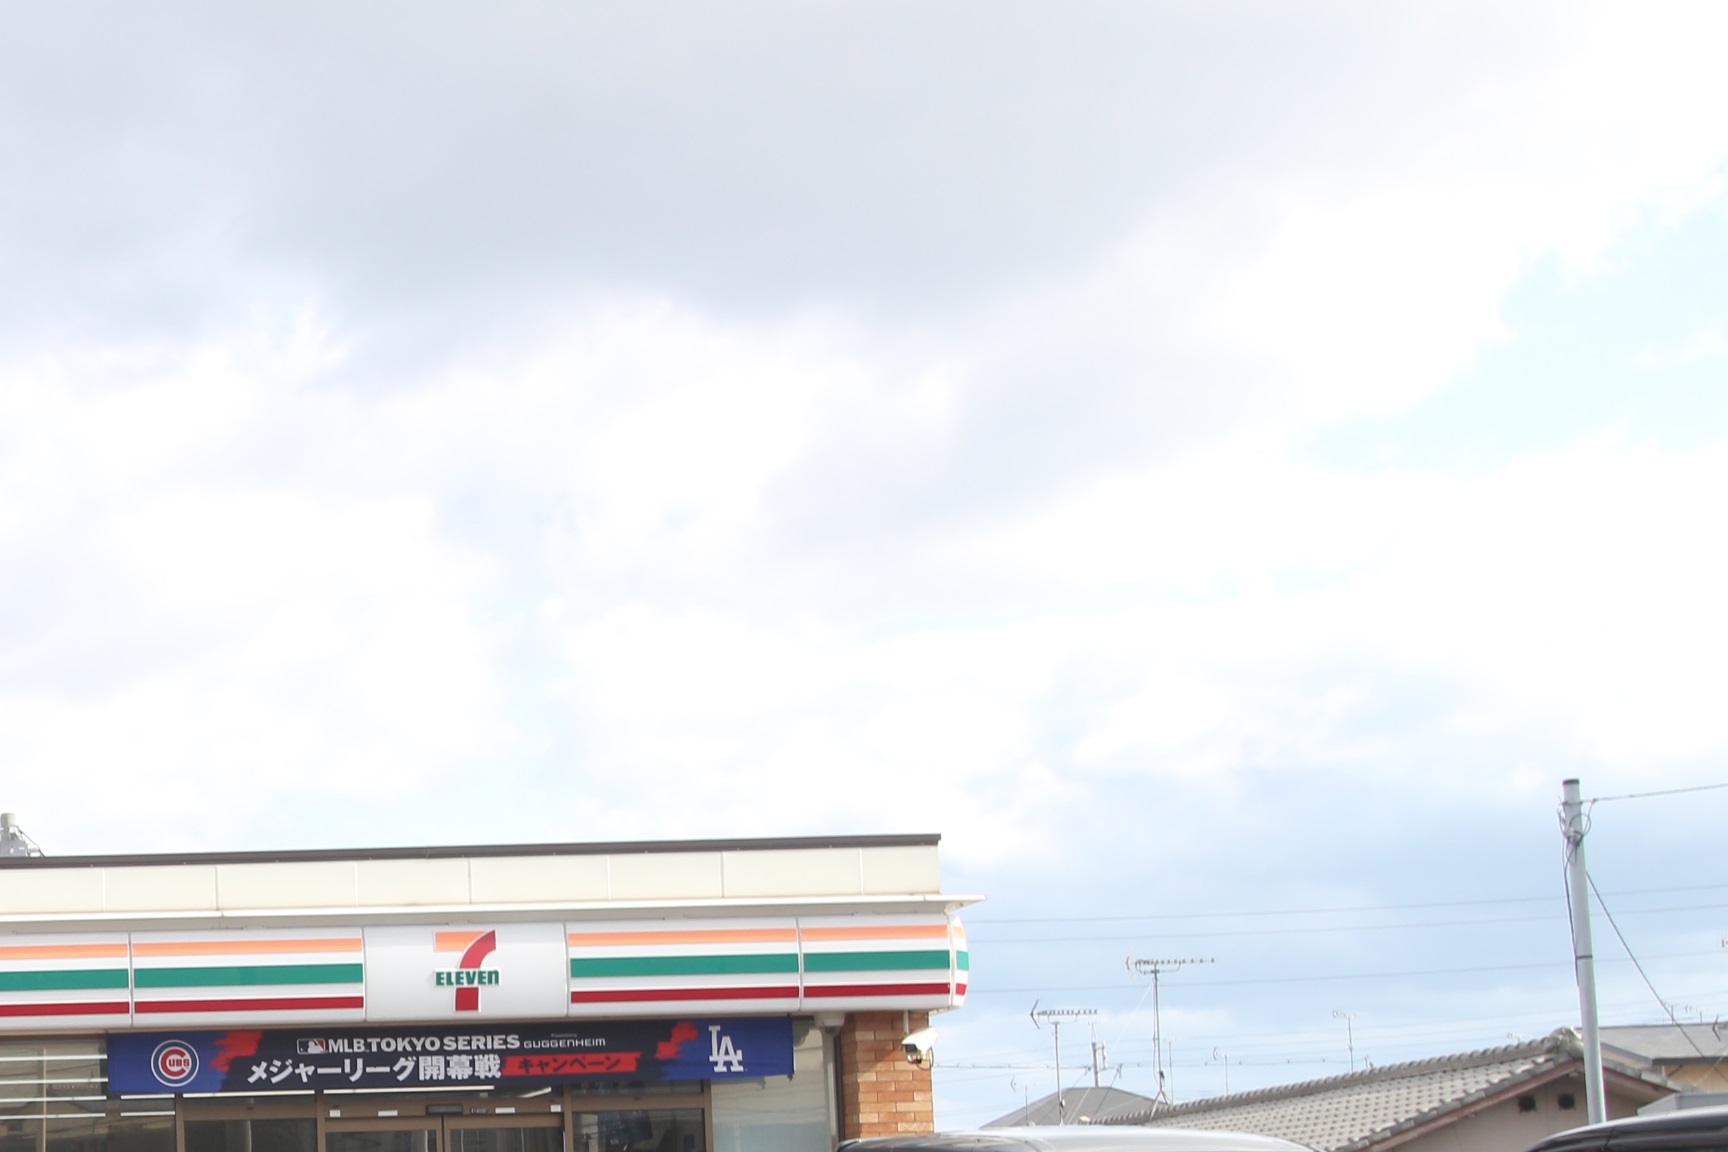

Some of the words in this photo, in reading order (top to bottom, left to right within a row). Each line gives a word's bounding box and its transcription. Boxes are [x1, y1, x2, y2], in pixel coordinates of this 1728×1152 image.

[328, 1039, 365, 1053] MLB
[367, 1037, 441, 1053] TOKYO
[443, 1035, 521, 1051] SERIES
[708, 1025, 744, 1072] LA
[247, 1054, 502, 1084] メジャーリーグ開幕戦
[518, 1056, 622, 1074] キャンペーン
